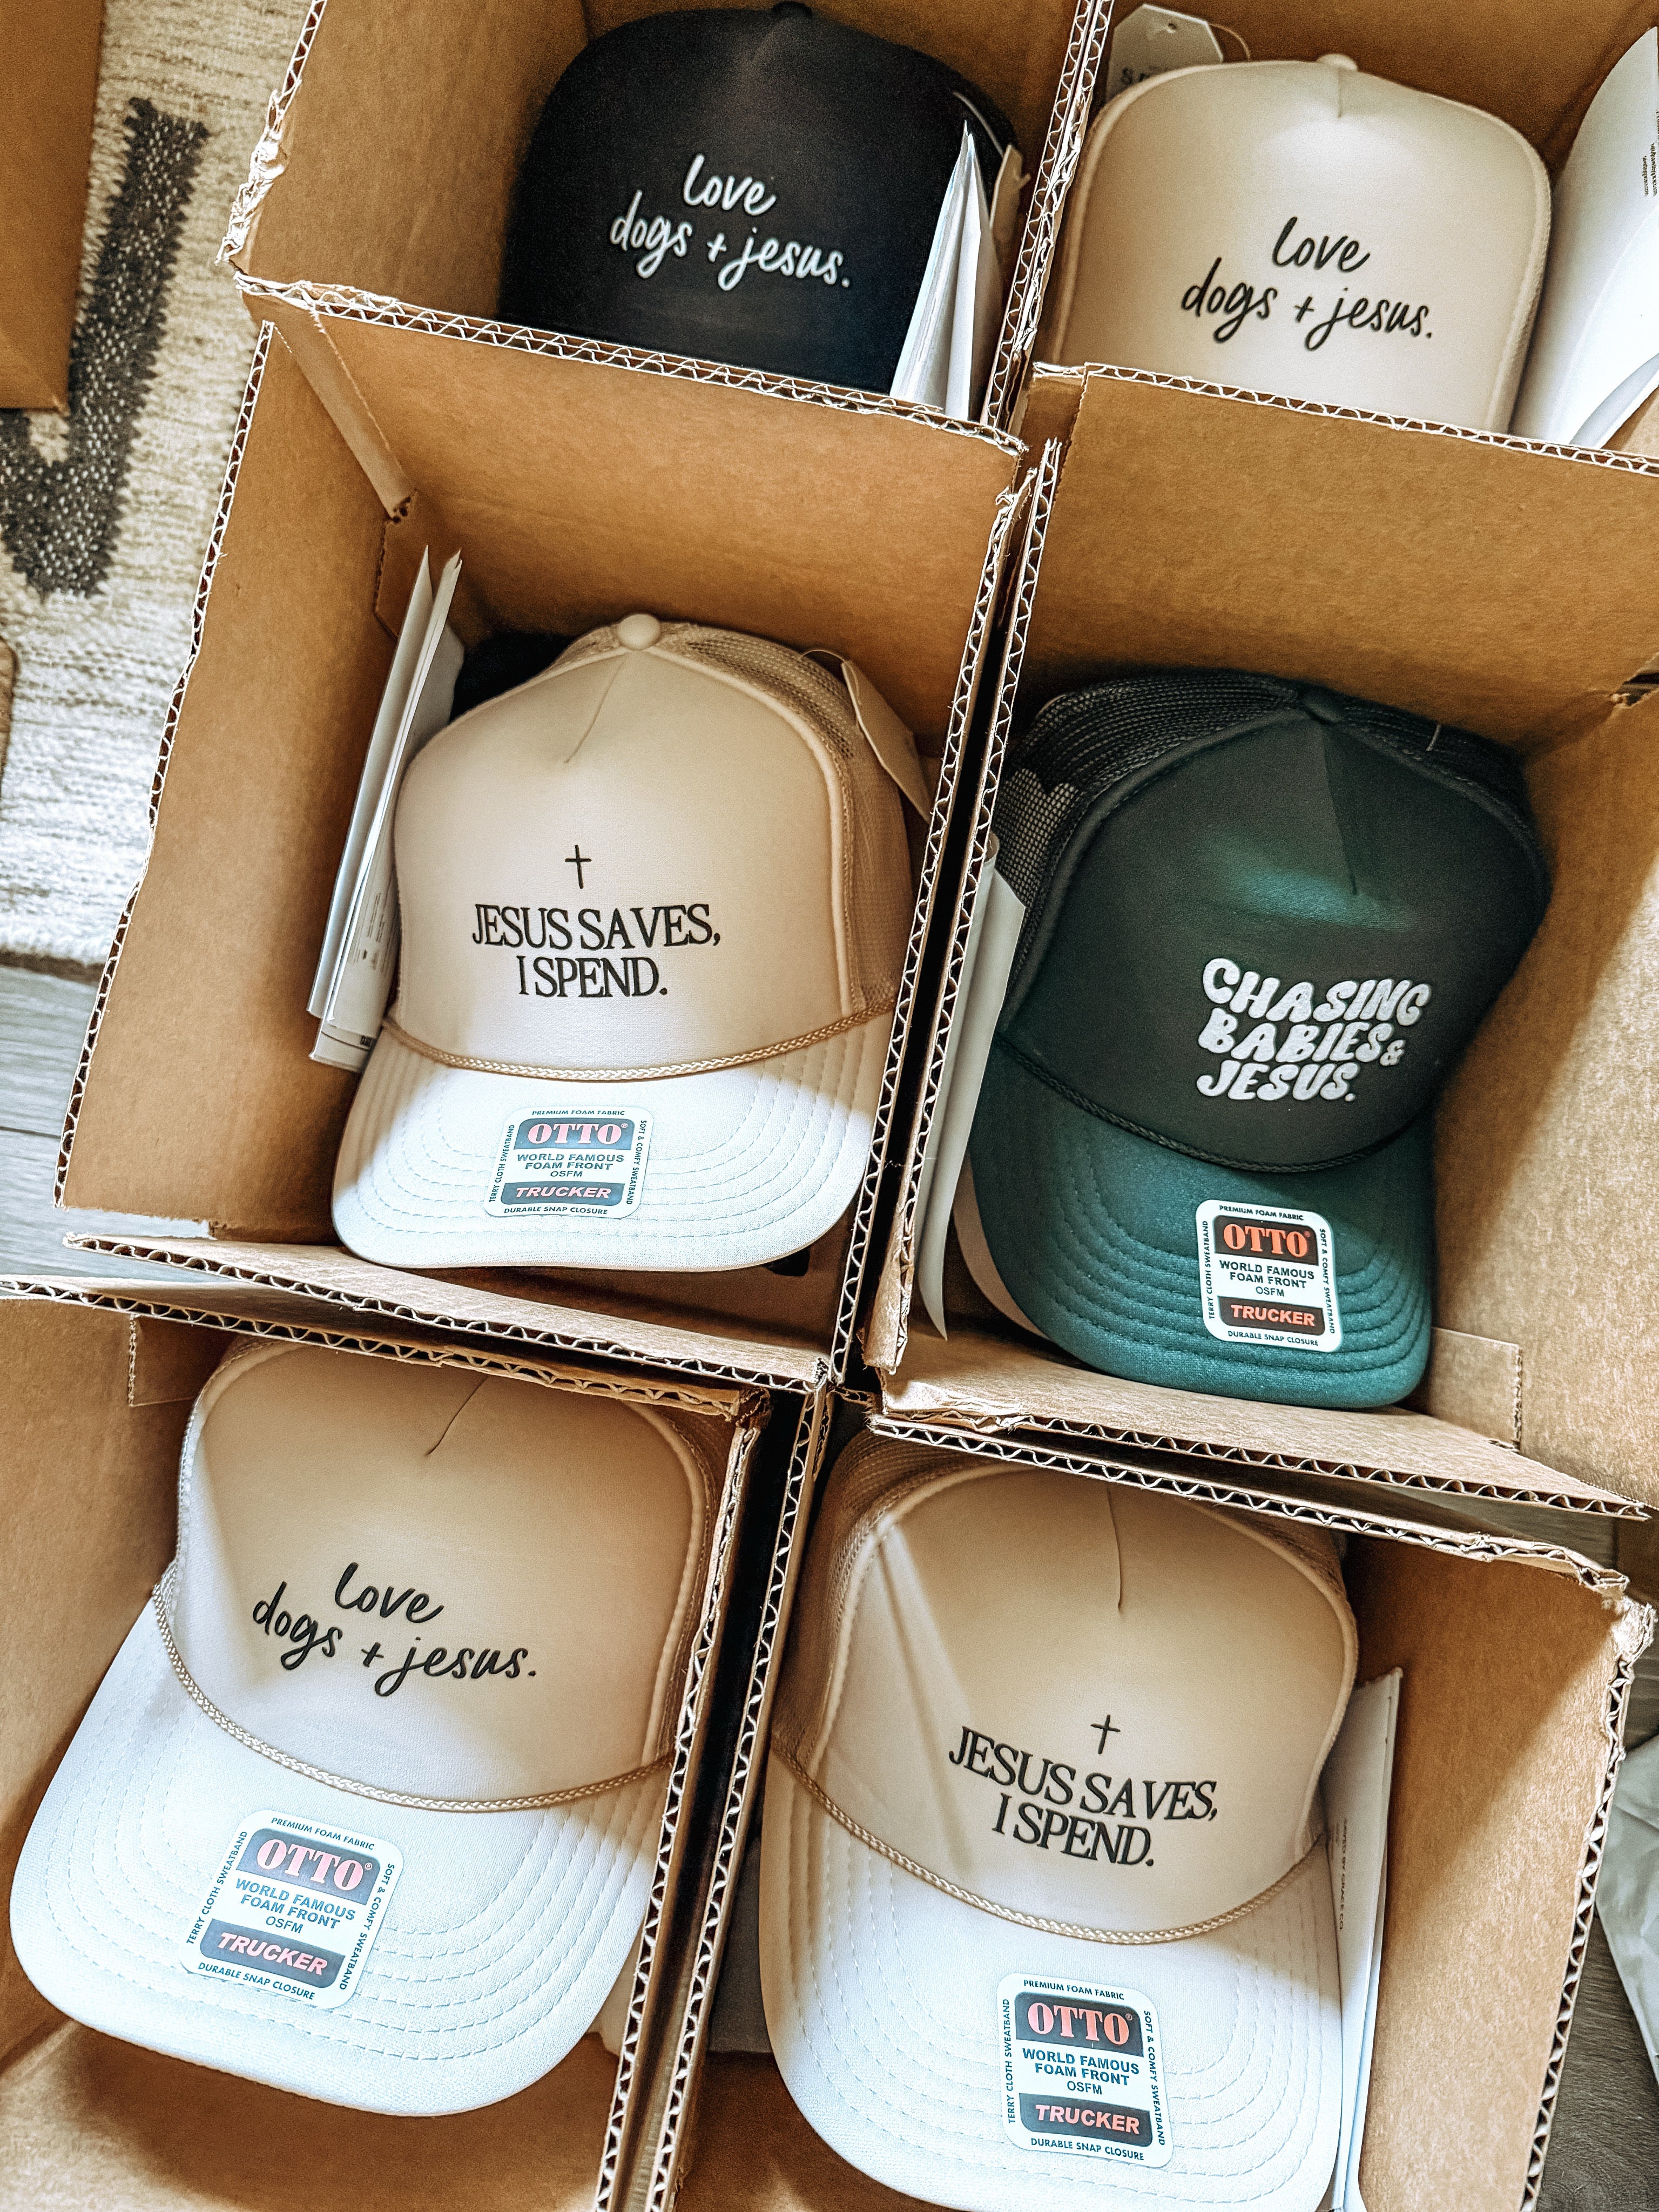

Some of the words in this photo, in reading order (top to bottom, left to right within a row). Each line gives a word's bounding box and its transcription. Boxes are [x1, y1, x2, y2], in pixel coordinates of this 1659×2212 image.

[610, 189, 692, 279] dogs
[717, 227, 850, 291] jesus.
[1181, 257, 1277, 343] dogs
[1304, 286, 1433, 351] jesus.
[473, 903, 572, 950] JESUS
[578, 903, 720, 950] SAVES,
[516, 955, 527, 995] I
[533, 956, 668, 998] SPEND.
[1203, 958, 1431, 1026] CHASING
[1196, 1060, 1359, 1102] JESUS.
[639, 1120, 647, 1134] SOFT
[489, 1184, 500, 1202] TERRY
[495, 1163, 505, 1183] CLOTH
[500, 1125, 515, 1162] SWEATBAND
[569, 1154, 624, 1162] FAMOUS
[633, 1143, 643, 1164] COMFY
[516, 1186, 611, 1198] TRUCKER
[626, 1167, 639, 1204] SWEATBAND
[1219, 1205, 1253, 1214] PREMIUM
[1256, 1209, 1277, 1217] FOAM
[1279, 1212, 1303, 1220] FABRIC
[1202, 1220, 1211, 1268] SWEATBAND
[1219, 1260, 1262, 1273] WORLD
[1267, 1266, 1314, 1279] FAMOUS
[1230, 1272, 1263, 1283] FOAM
[1268, 1277, 1306, 1288] FRONT
[1256, 1286, 1284, 1297] OSFM
[1231, 1305, 1314, 1326] TRUCKER
[1324, 1287, 1334, 1333] SWEATBAND
[1228, 1331, 1262, 1339] DURABLE
[1287, 1337, 1318, 1346] CLOSURE
[252, 1581, 343, 1670] dogs
[374, 1637, 536, 1697] jesus.
[948, 1726, 1076, 1805] JESUS
[1080, 1772, 1218, 1821] SAVES,
[271, 1817, 313, 1833] PREMIUM
[314, 1827, 341, 1841] FOAM
[343, 1836, 374, 1850] FABRIC
[992, 1792, 1012, 1835] I
[1013, 1802, 1154, 1866] SPEND.
[186, 1917, 204, 1945] TERRY
[201, 1886, 220, 1915] CLOTH
[217, 1831, 247, 1884] SWEATBAND
[379, 1863, 395, 1885] SOFT
[236, 1878, 290, 1901] WORLD
[293, 1894, 356, 1920] FAMOUS
[240, 1895, 285, 1914] FOAM
[287, 1907, 341, 1929] FRONT
[366, 1897, 382, 1931] COMFY
[266, 1916, 304, 1933] OSFM
[218, 1932, 327, 1975] TRUCKER
[340, 1932, 367, 1990] SWEATBAND
[198, 1962, 241, 1979] DURABLE
[243, 1973, 271, 1986] SNAP
[273, 1981, 315, 2000] CLOSURE
[1023, 1980, 1064, 1991] PREMIUM
[1067, 1985, 1092, 1995] FOAM
[1095, 1988, 1124, 2000] FABRIC
[1003, 1999, 1012, 2057] SWEATBAND
[1144, 2010, 1152, 2033] SOFT
[1022, 2048, 1075, 2064] WORLD
[1080, 2055, 1139, 2074] FAMOUS
[1035, 2063, 1077, 2077] FOAM
[1082, 2069, 1129, 2086] FRONT
[1148, 2046, 1157, 2082] COMFY
[1067, 2081, 1103, 2095] OSFM
[1007, 2095, 1015, 2123] TERRY
[1035, 2105, 1139, 2134] TRUCKER
[1151, 2085, 1165, 2146] SWEATBAND
[1031, 2137, 1073, 2149] DURABLE
[1076, 2142, 1101, 2153] SNAP
[1105, 2146, 1144, 2161] CLOSURE
